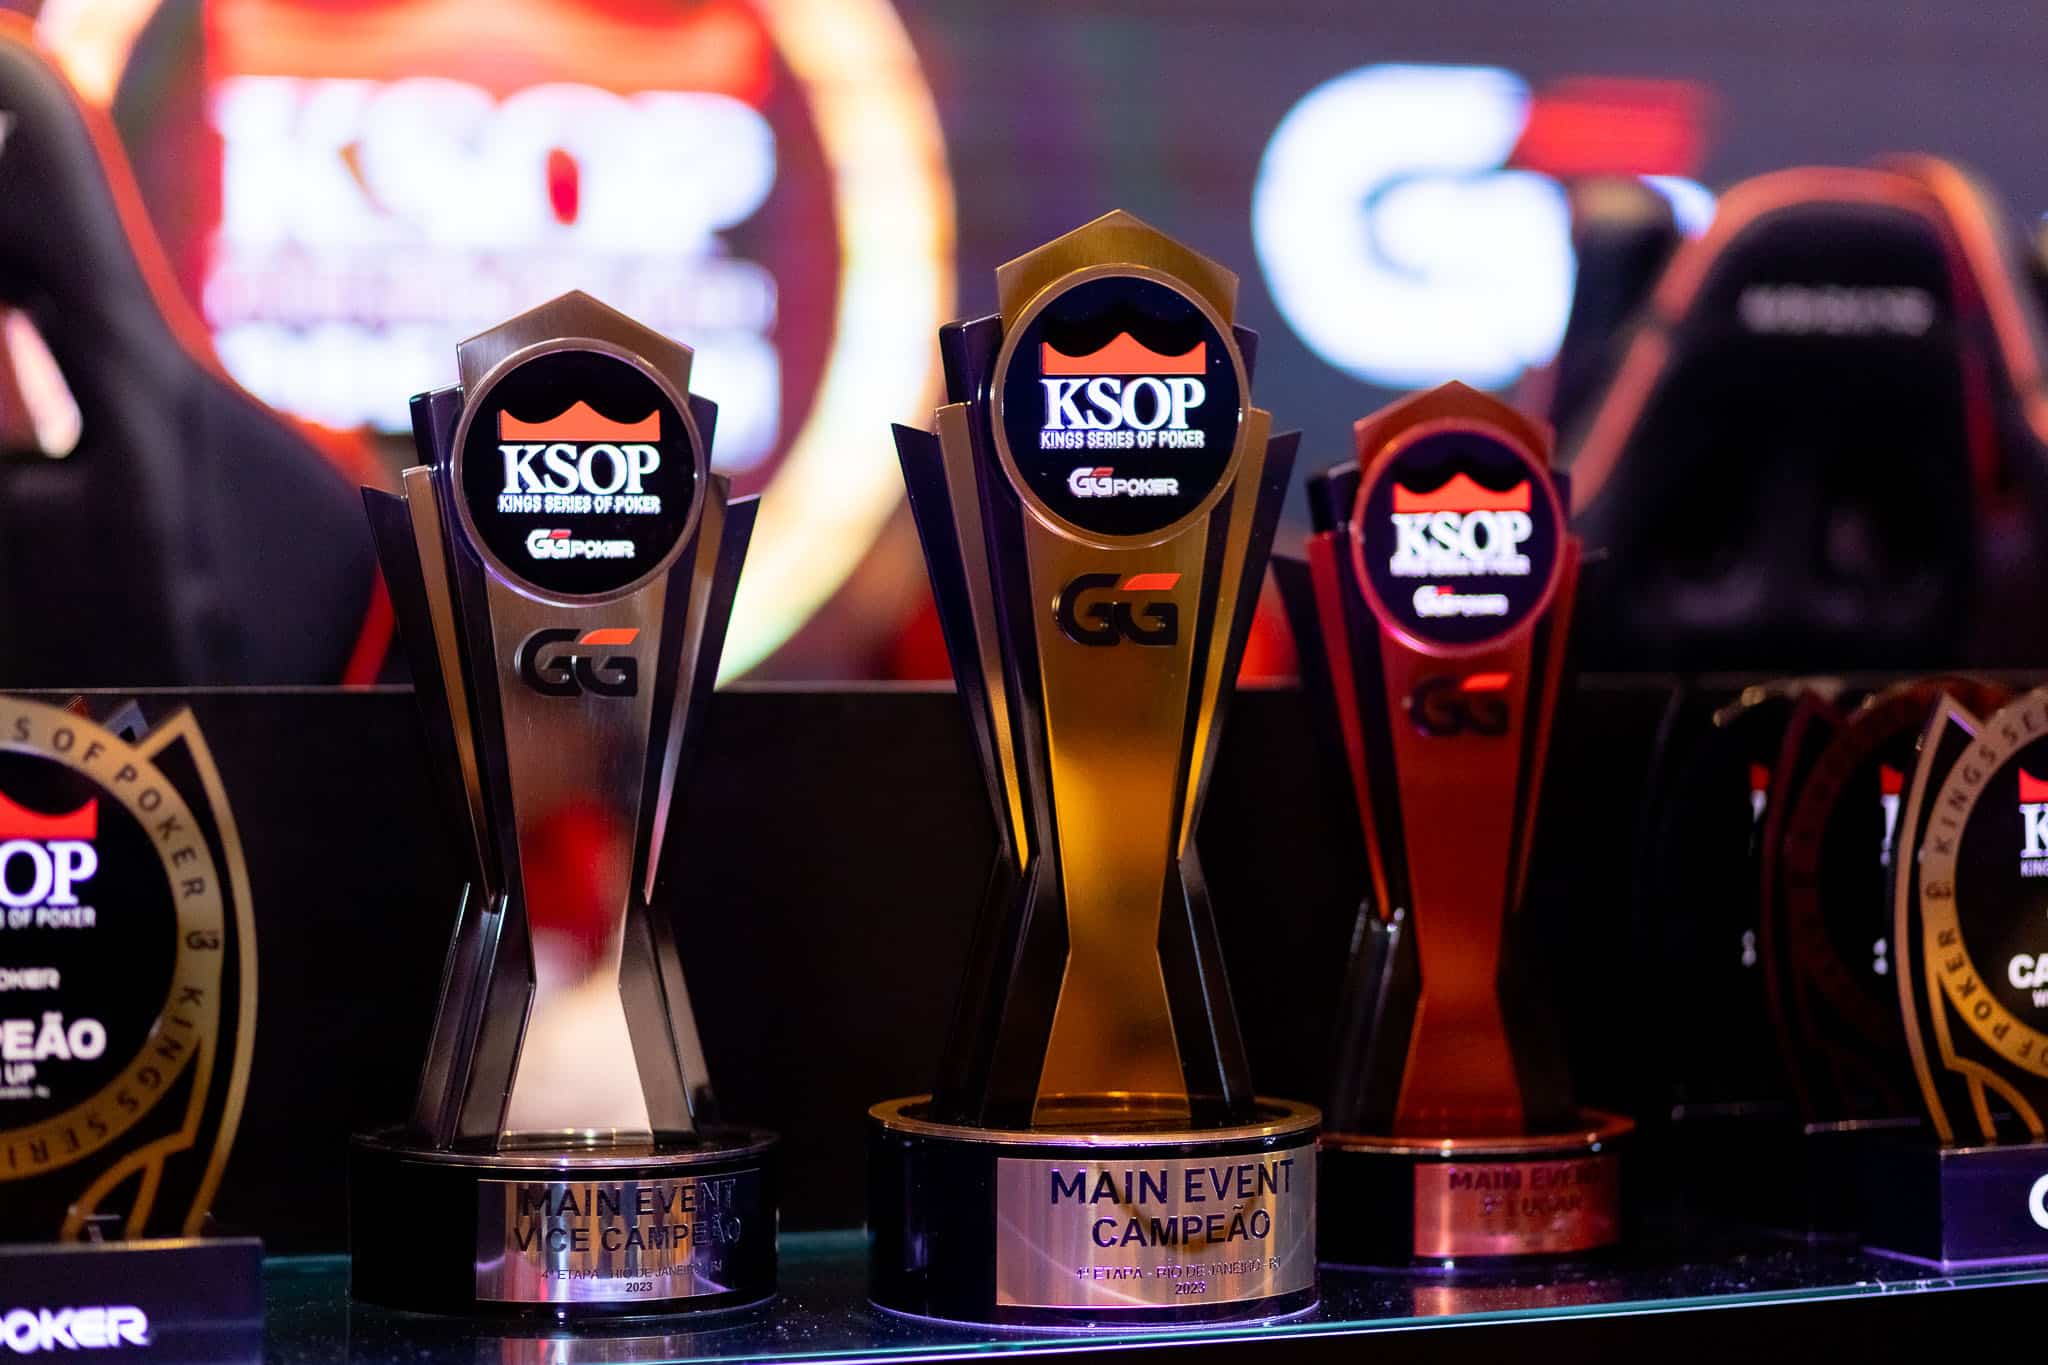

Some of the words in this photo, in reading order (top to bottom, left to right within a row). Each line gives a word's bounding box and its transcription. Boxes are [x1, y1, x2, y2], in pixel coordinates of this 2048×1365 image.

[1040, 377, 1206, 430] KSOP
[1041, 431, 1083, 449] KINGS
[1087, 431, 1134, 449] SERIES
[1137, 431, 1156, 448] OF
[1159, 431, 1205, 448] POKER
[498, 444, 661, 494] KSOP
[498, 495, 541, 513] KINGS
[544, 495, 591, 513] SERIES
[594, 495, 612, 514] OF
[615, 496, 661, 514] POKER
[1391, 511, 1532, 560] KSOP
[1052, 573, 1182, 646] GG
[515, 628, 640, 697] GG
[115, 763, 206, 898] POKER
[0, 1011, 107, 1060] EÃO
[519, 1187, 621, 1217] MAIN
[636, 1179, 737, 1214] EVENT
[1051, 1168, 1168, 1204] MAIN
[1184, 1158, 1294, 1203] EVENT
[513, 1227, 590, 1252] VICE
[601, 1212, 742, 1251] CAMPEÃO
[1092, 1204, 1271, 1247] CAMPEÃO
[625, 1281, 653, 1293] 2023
[1093, 1265, 1143, 1280] ETAPA
[1174, 1280, 1206, 1295] 2023
[0, 1305, 150, 1353] OKER
